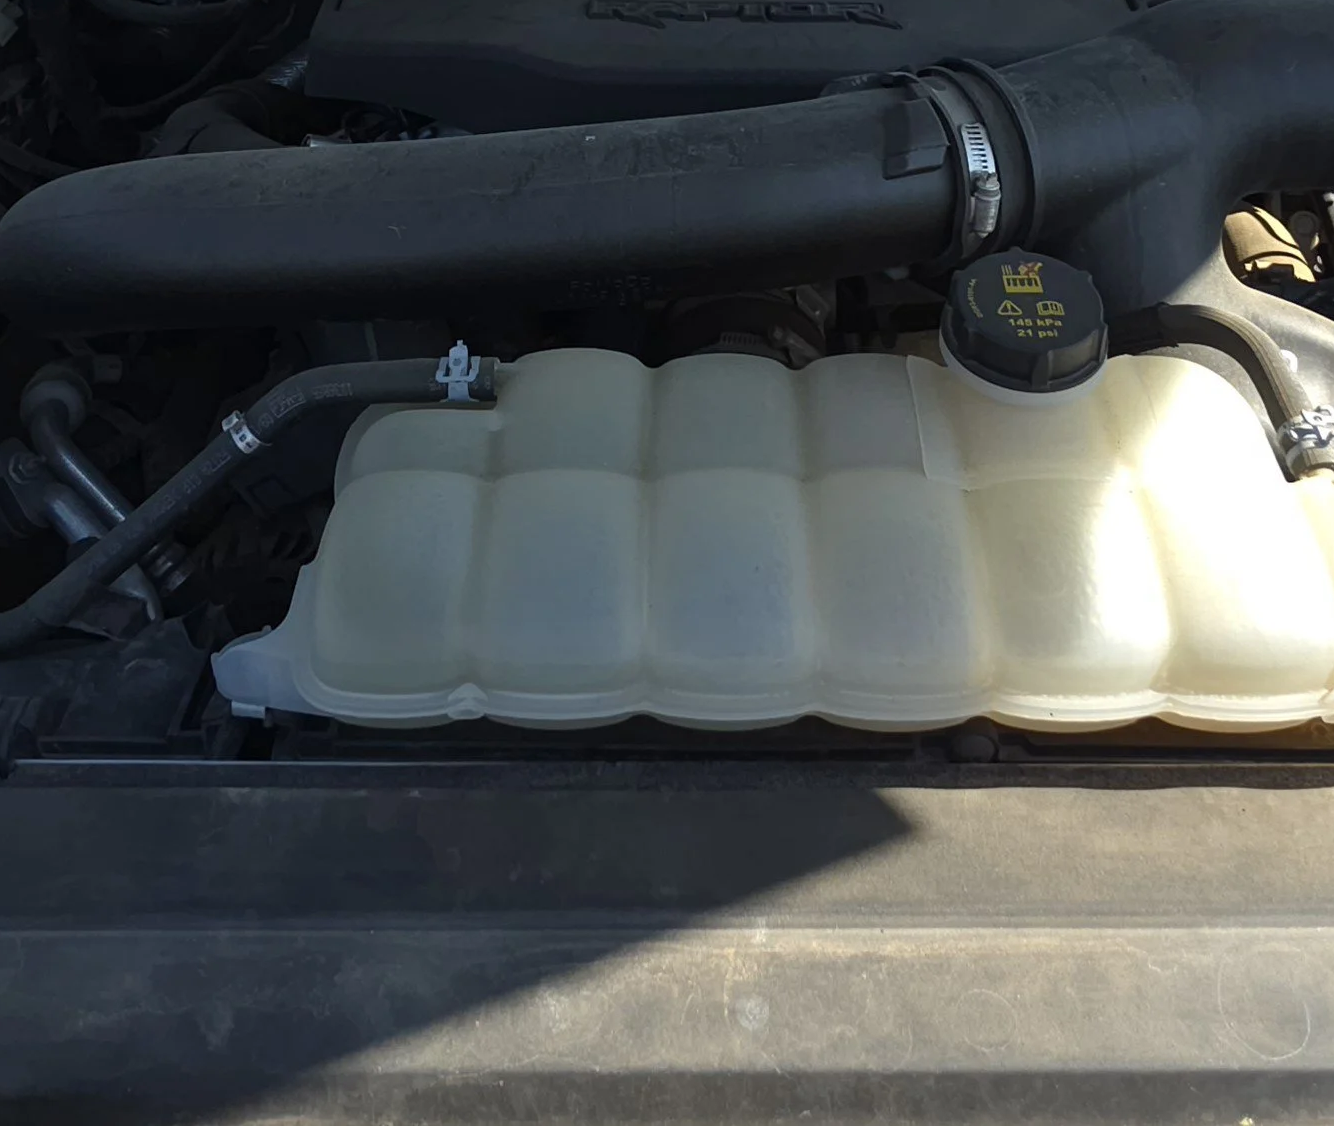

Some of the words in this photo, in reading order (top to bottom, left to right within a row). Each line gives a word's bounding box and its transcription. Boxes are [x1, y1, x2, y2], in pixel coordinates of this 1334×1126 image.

[1008, 318, 1033, 327] 145
[1037, 318, 1063, 327] kPa
[1016, 329, 1033, 338] 21
[1038, 329, 1059, 339] psi
